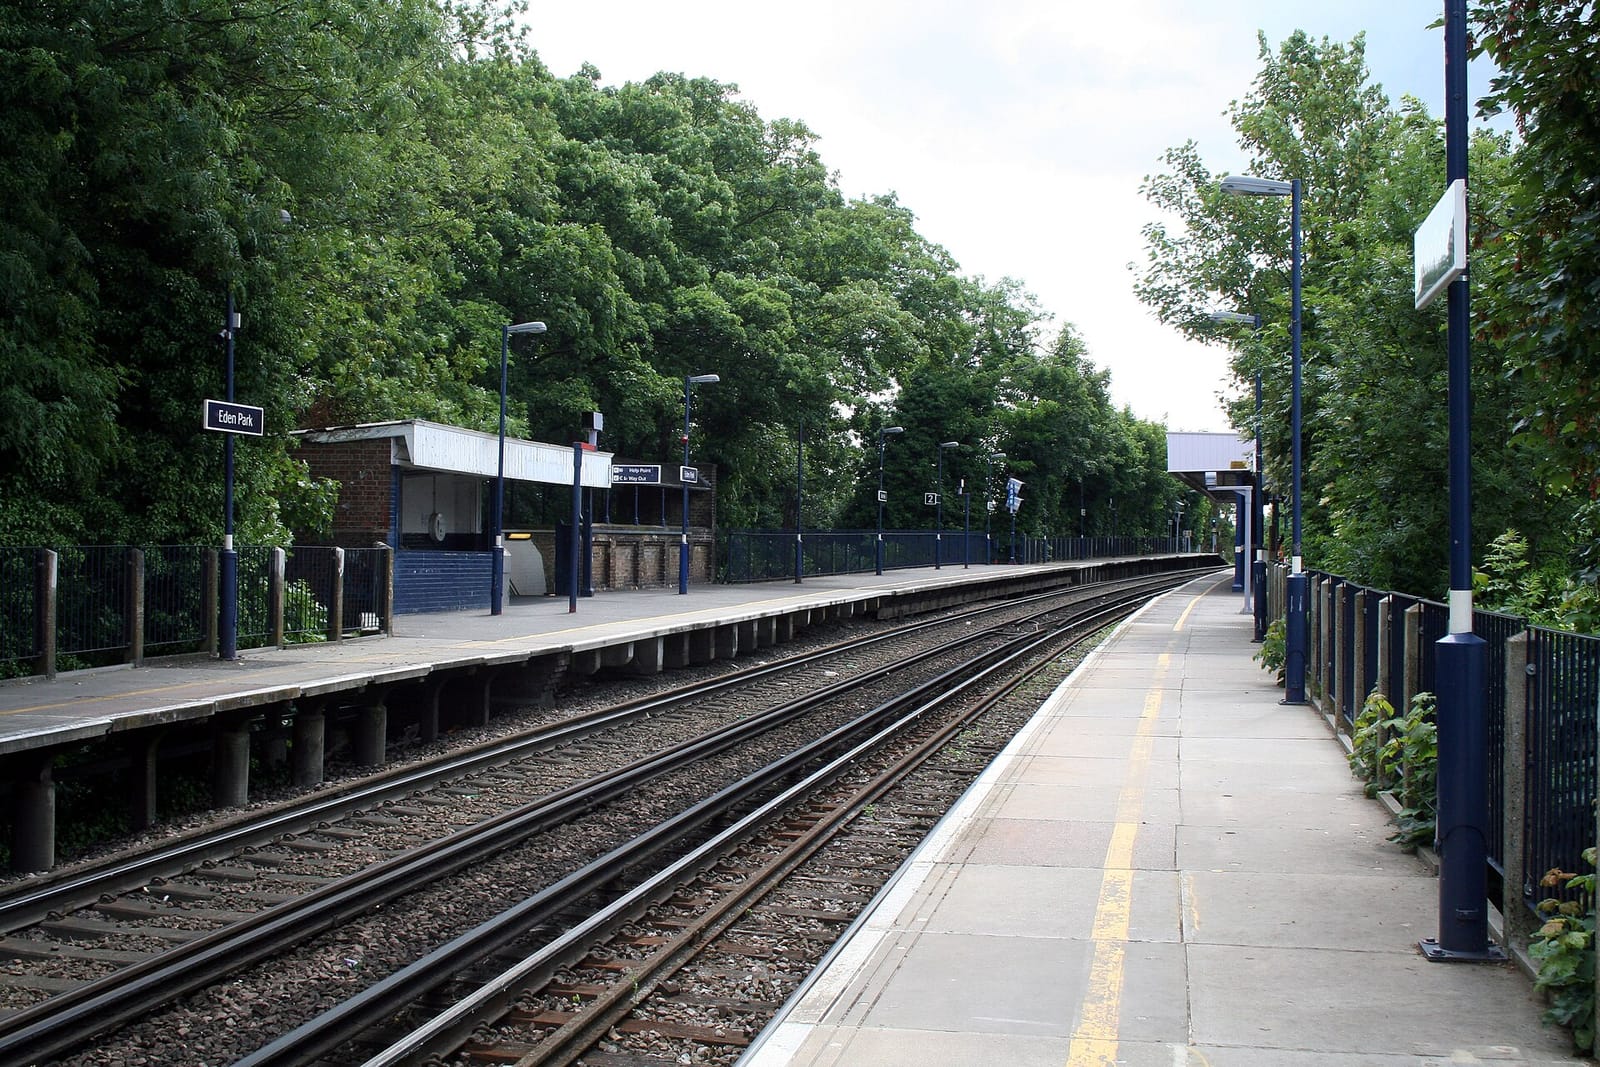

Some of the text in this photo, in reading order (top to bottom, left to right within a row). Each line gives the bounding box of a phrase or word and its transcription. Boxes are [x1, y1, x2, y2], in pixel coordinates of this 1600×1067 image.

[218, 409, 253, 427] Eden Park
[927, 494, 934, 503] 2
